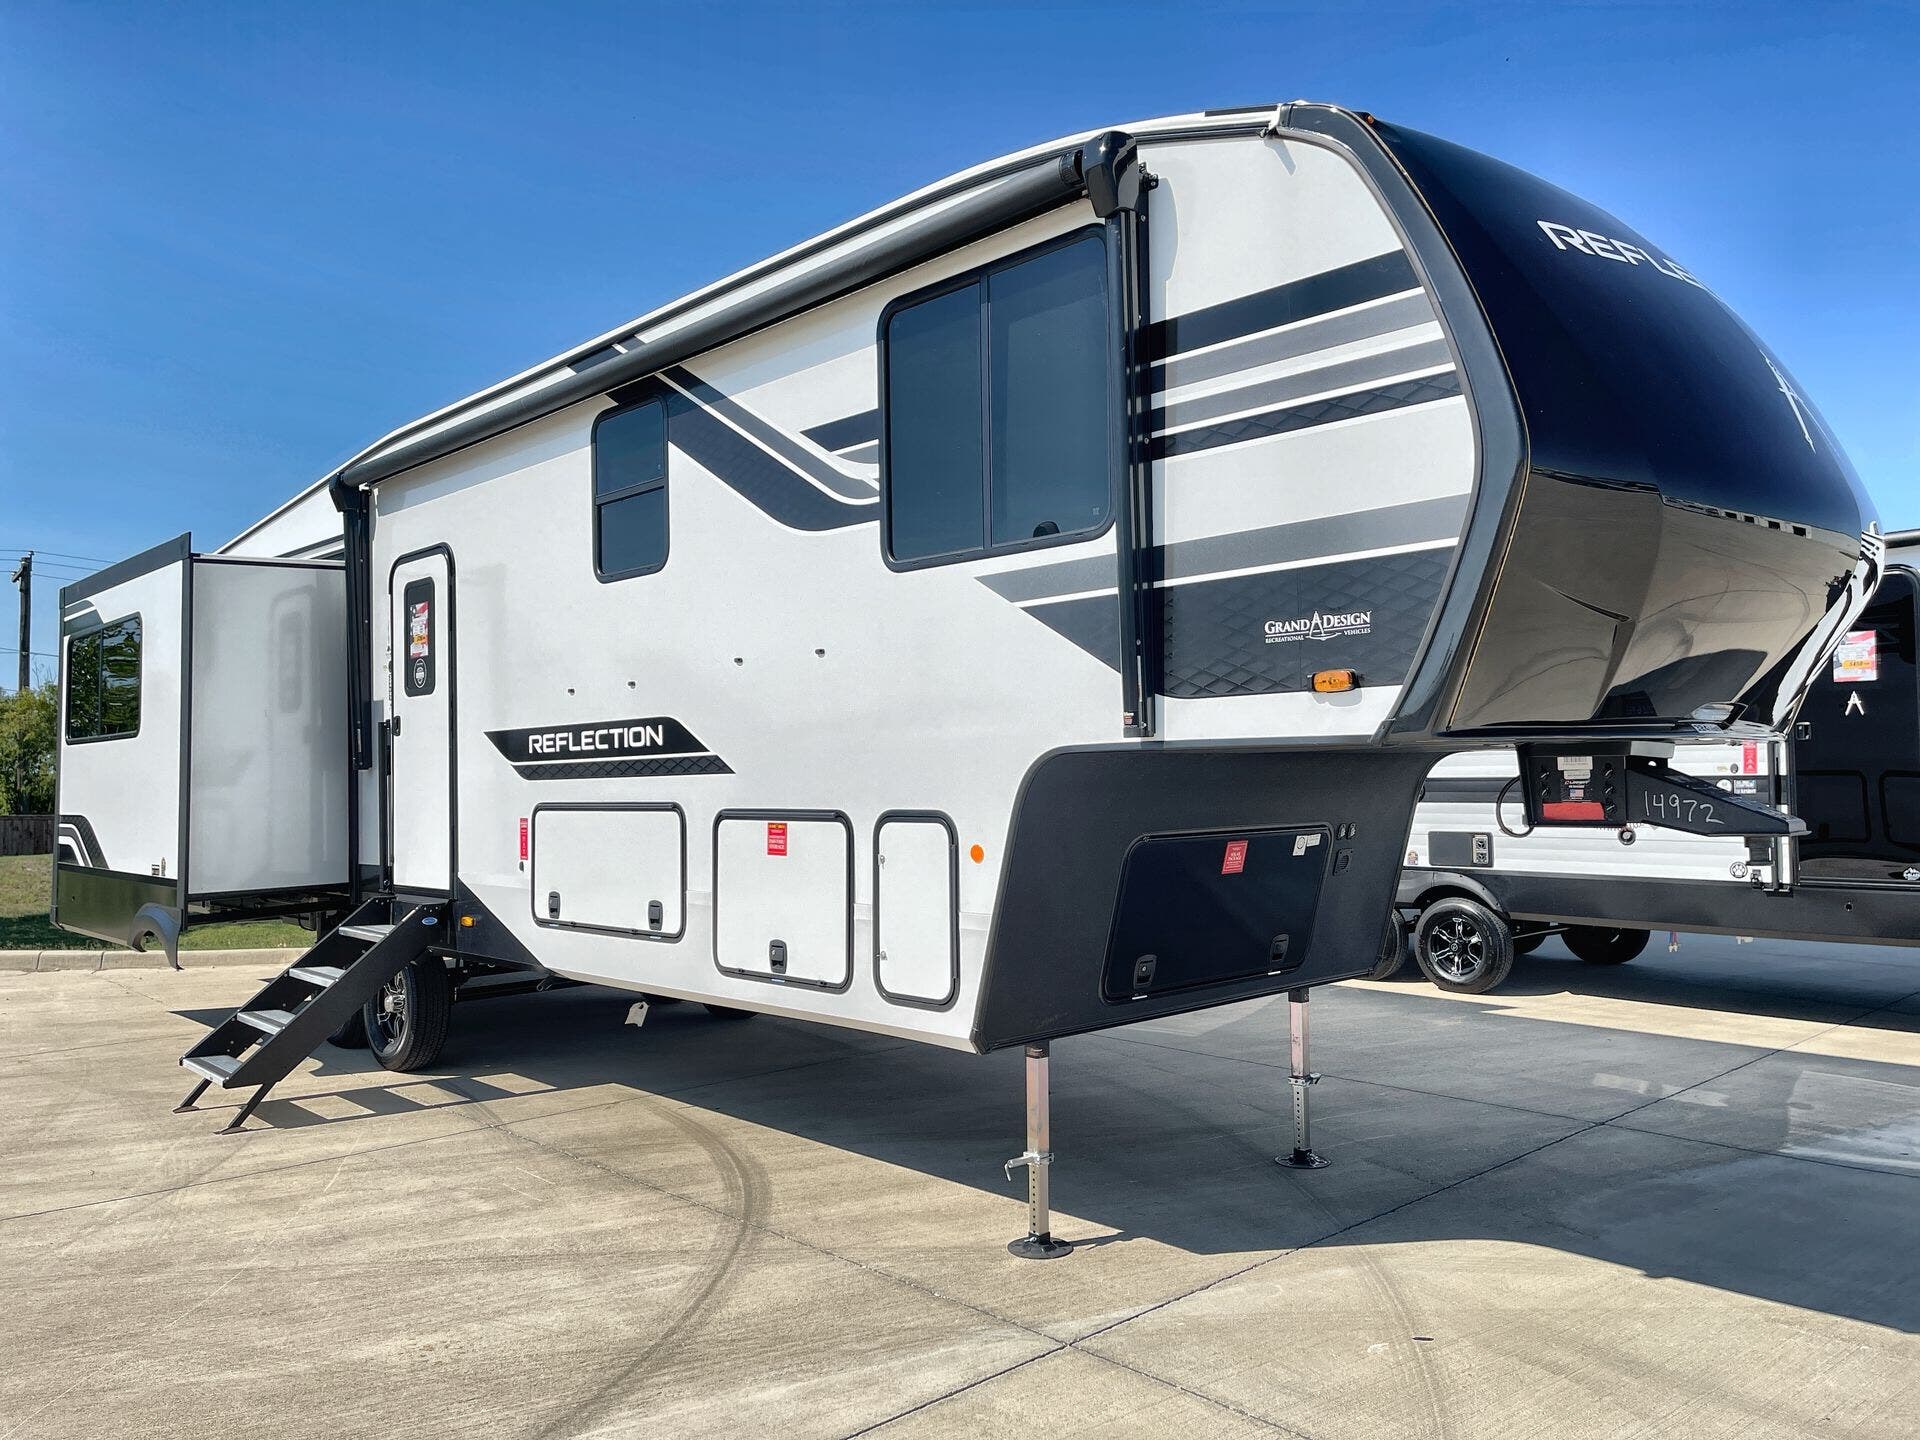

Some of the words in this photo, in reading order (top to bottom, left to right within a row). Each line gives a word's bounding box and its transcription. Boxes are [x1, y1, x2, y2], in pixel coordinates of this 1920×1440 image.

[1264, 619, 1310, 633] GRAND
[1322, 611, 1371, 628] DESIGN
[1265, 635, 1304, 643] RECREATIONAL
[528, 724, 664, 754] REFLECTION
[1644, 790, 1725, 825] 14972
